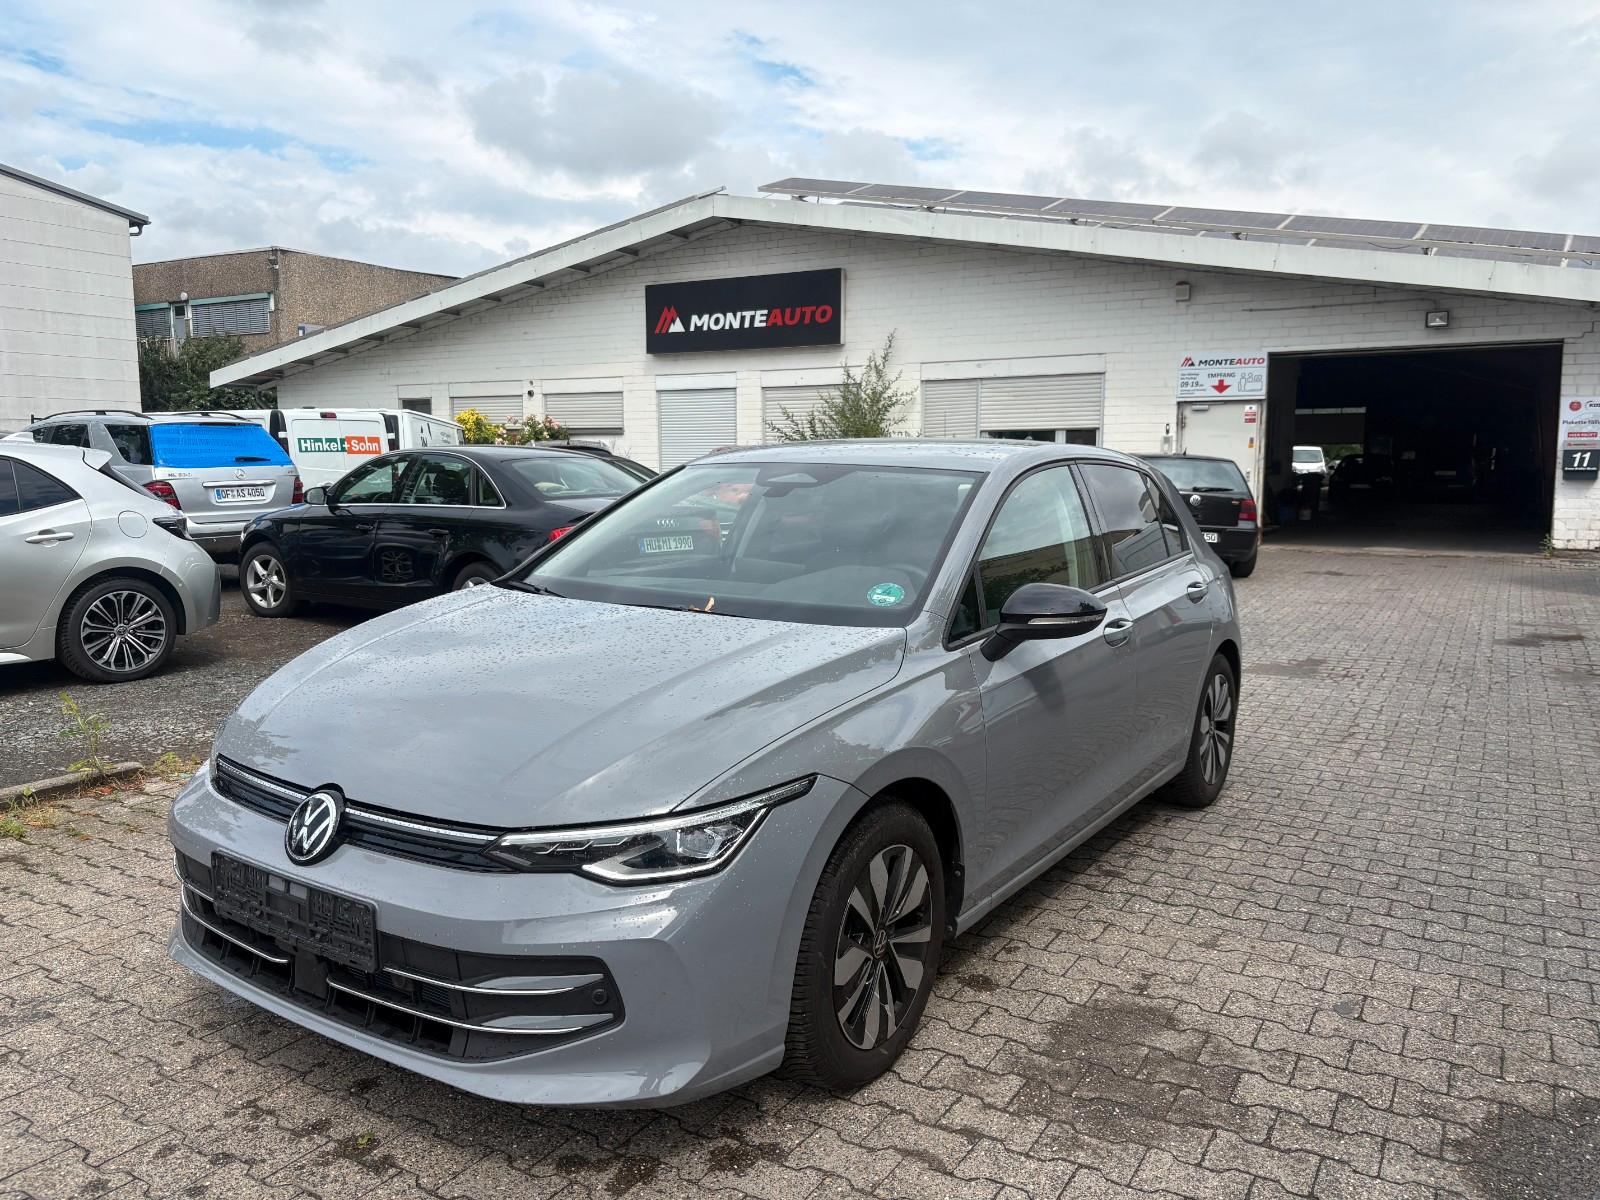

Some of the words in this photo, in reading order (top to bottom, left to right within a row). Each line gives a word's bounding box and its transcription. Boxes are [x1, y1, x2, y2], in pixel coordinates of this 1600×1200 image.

[689, 304, 833, 332] MONTEAUTO
[1198, 357, 1265, 367] MONTEAUTO
[1572, 451, 1591, 467] 11
[222, 489, 231, 499] OF
[236, 488, 246, 498] AS
[247, 487, 265, 497] 4050
[673, 536, 692, 549] 1990
